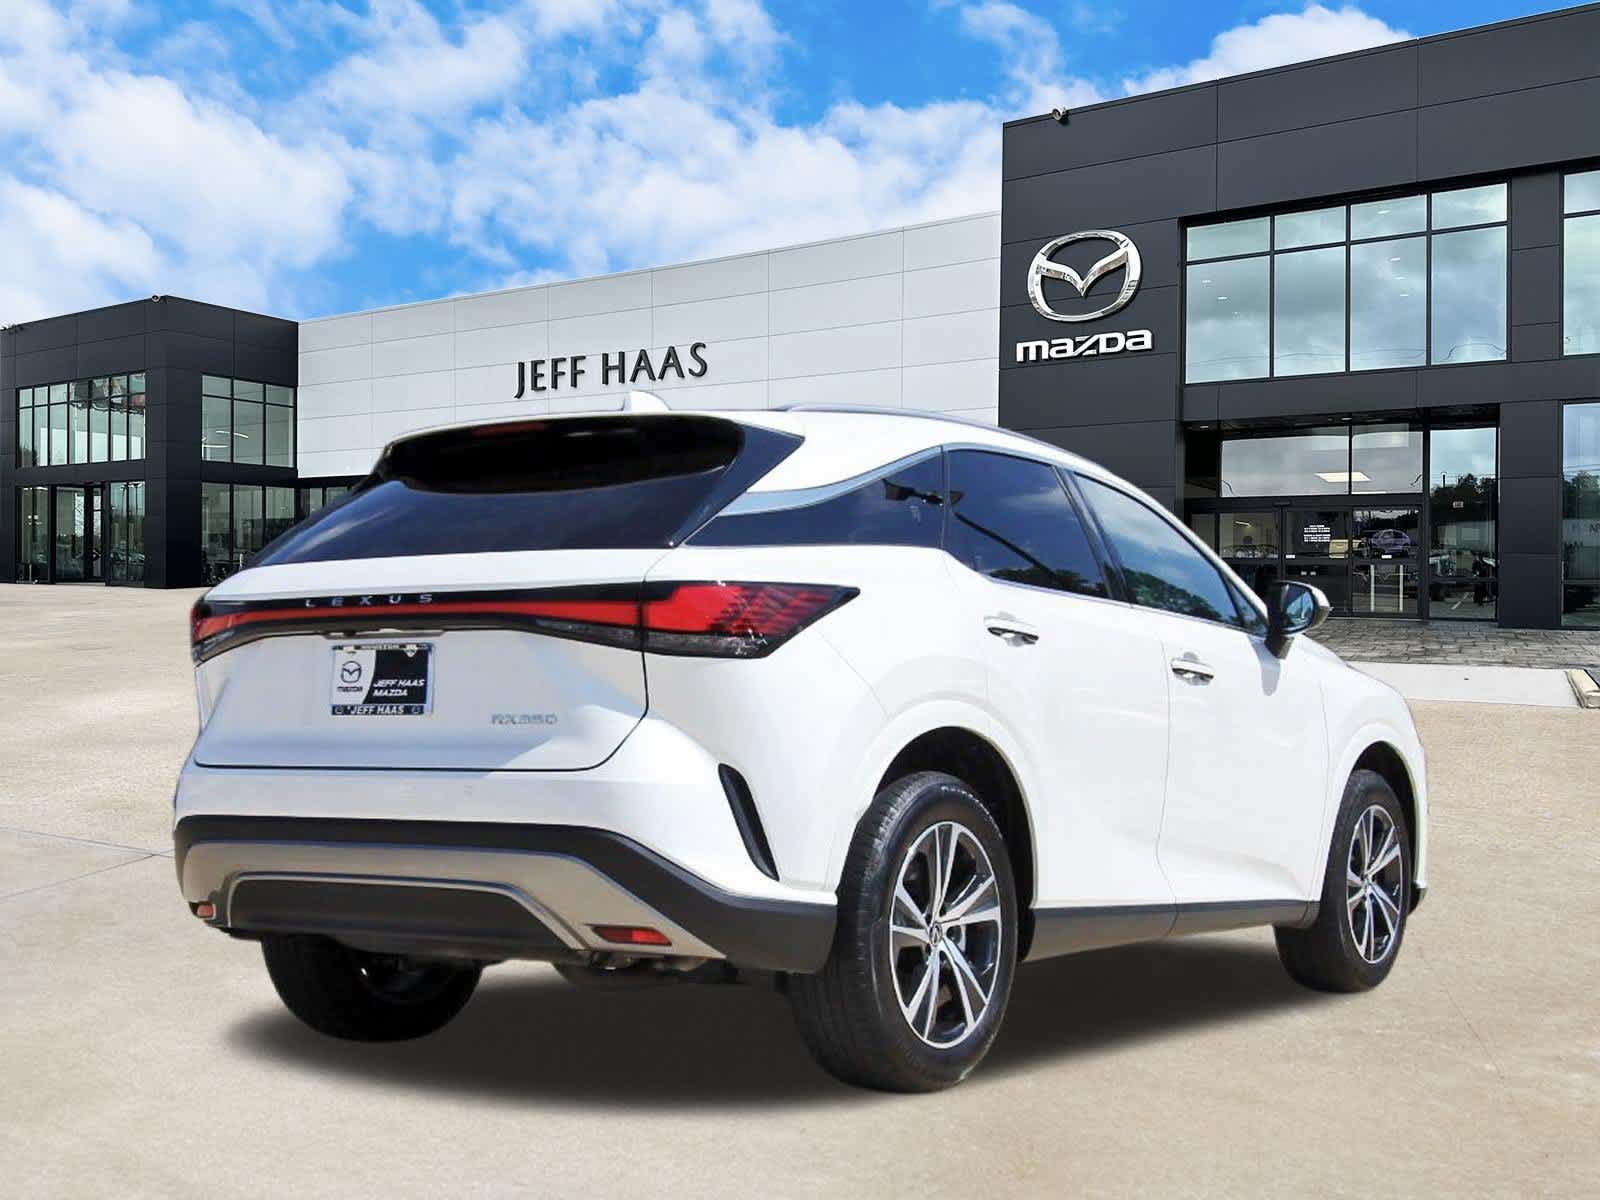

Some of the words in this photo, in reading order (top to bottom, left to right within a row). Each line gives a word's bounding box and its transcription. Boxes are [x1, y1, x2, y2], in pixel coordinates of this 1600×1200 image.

[514, 355, 587, 399] JEFF
[601, 342, 708, 385] HAAS
[305, 593, 433, 608] LEXUS
[373, 679, 398, 688] JEFF
[398, 679, 425, 687] HAAS
[372, 688, 408, 697] MAZDA
[350, 705, 375, 714] JEFF
[376, 705, 405, 714] HAAS
